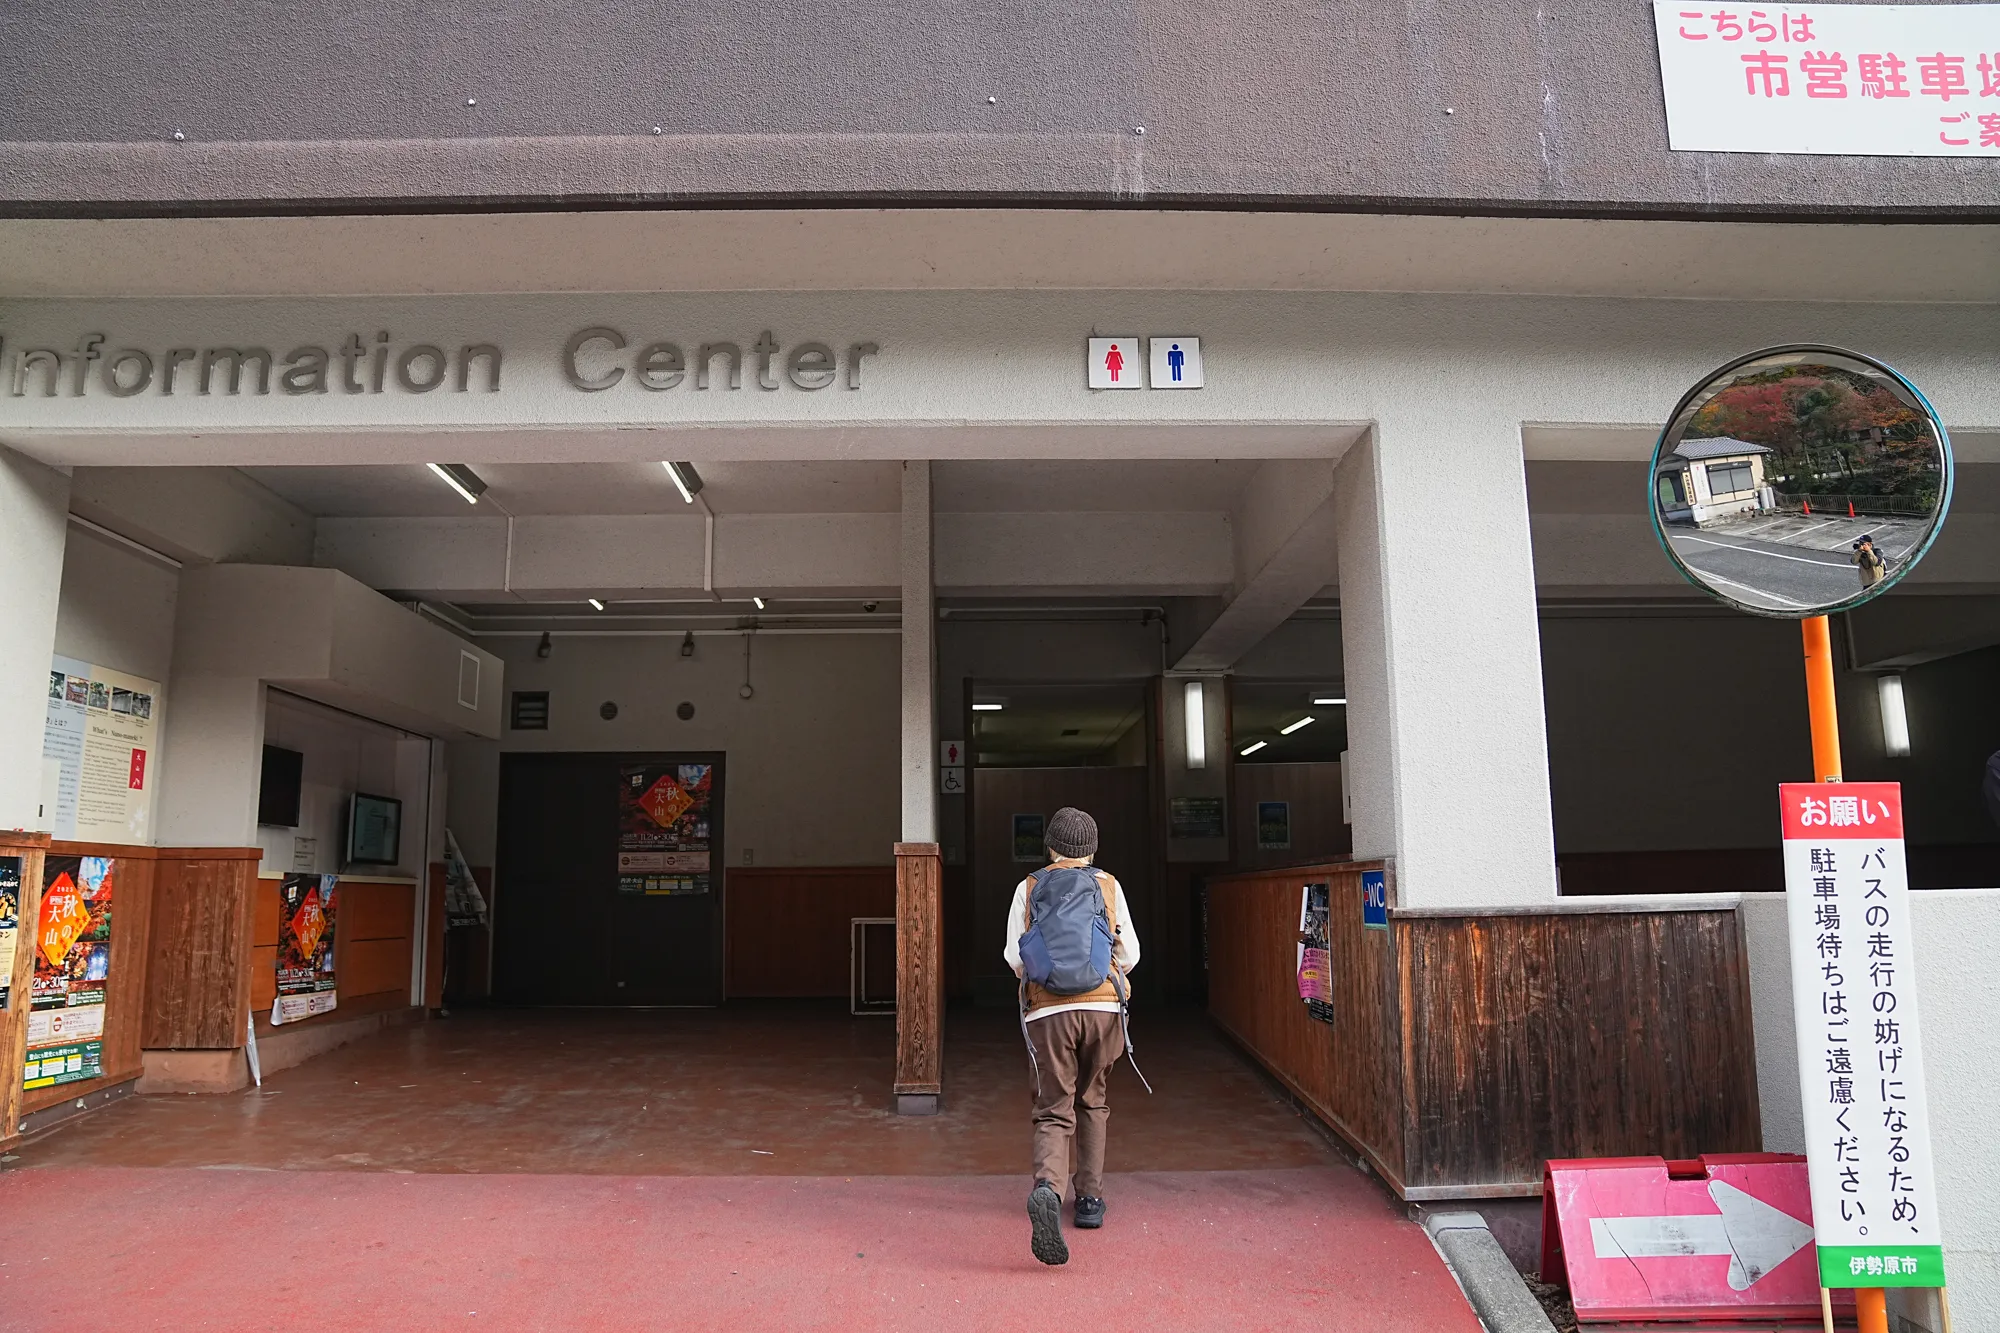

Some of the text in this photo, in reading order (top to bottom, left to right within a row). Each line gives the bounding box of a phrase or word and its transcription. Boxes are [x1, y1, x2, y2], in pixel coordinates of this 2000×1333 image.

[1679, 10, 1816, 43] こちらは
[0, 326, 880, 396] nformation Center
[1800, 796, 1890, 827] お願い
[1367, 882, 1385, 907] WC
[45, 905, 61, 946] 大山
[62, 894, 79, 938] 秋の
[1810, 848, 1868, 1236] 駐車場待ちはご遠慮ください。
[1861, 847, 1919, 1234] バスの走行の妨げになるため、
[1849, 1256, 1918, 1275] 伊勢原市
